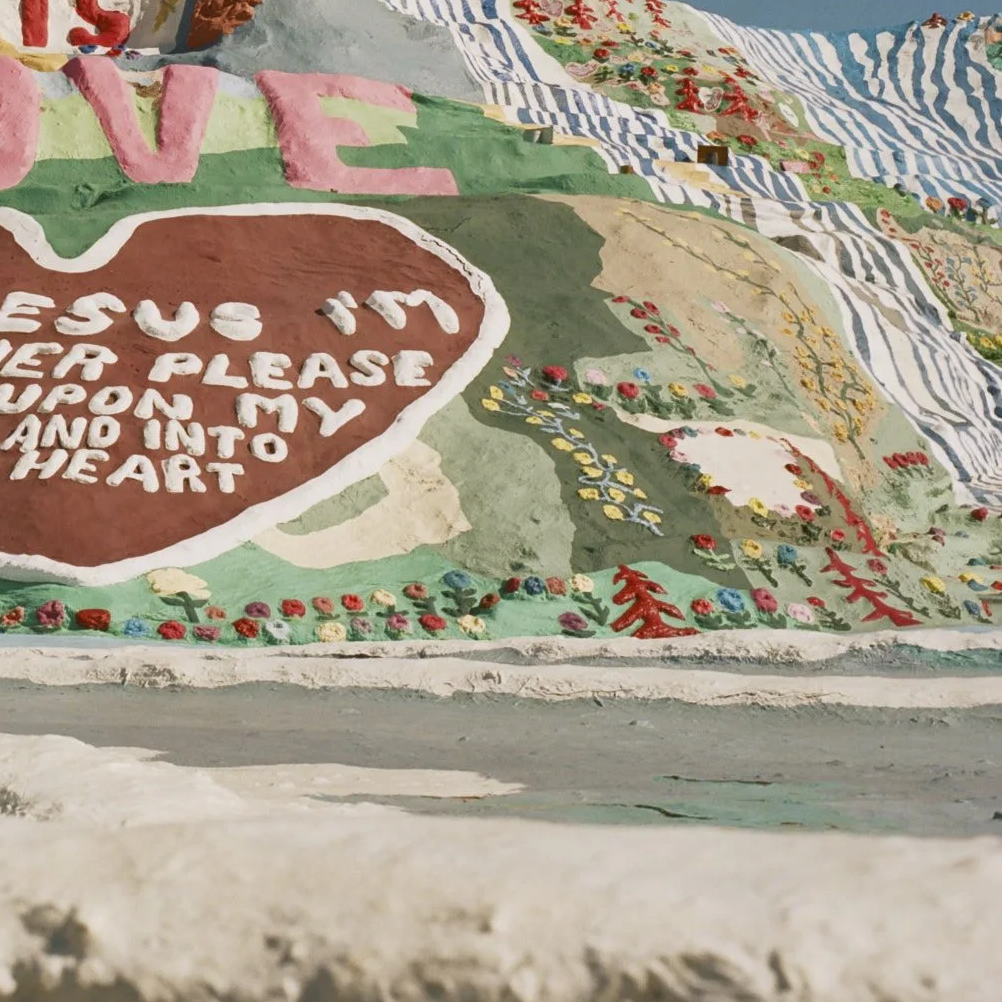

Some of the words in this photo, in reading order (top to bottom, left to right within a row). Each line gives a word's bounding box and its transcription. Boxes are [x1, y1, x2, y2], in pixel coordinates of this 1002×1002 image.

[148, 350, 433, 390] PLEASE
[236, 393, 366, 437] MY
[0, 414, 120, 452] AND
[143, 419, 288, 463] INTO
[10, 448, 245, 494] HEART
